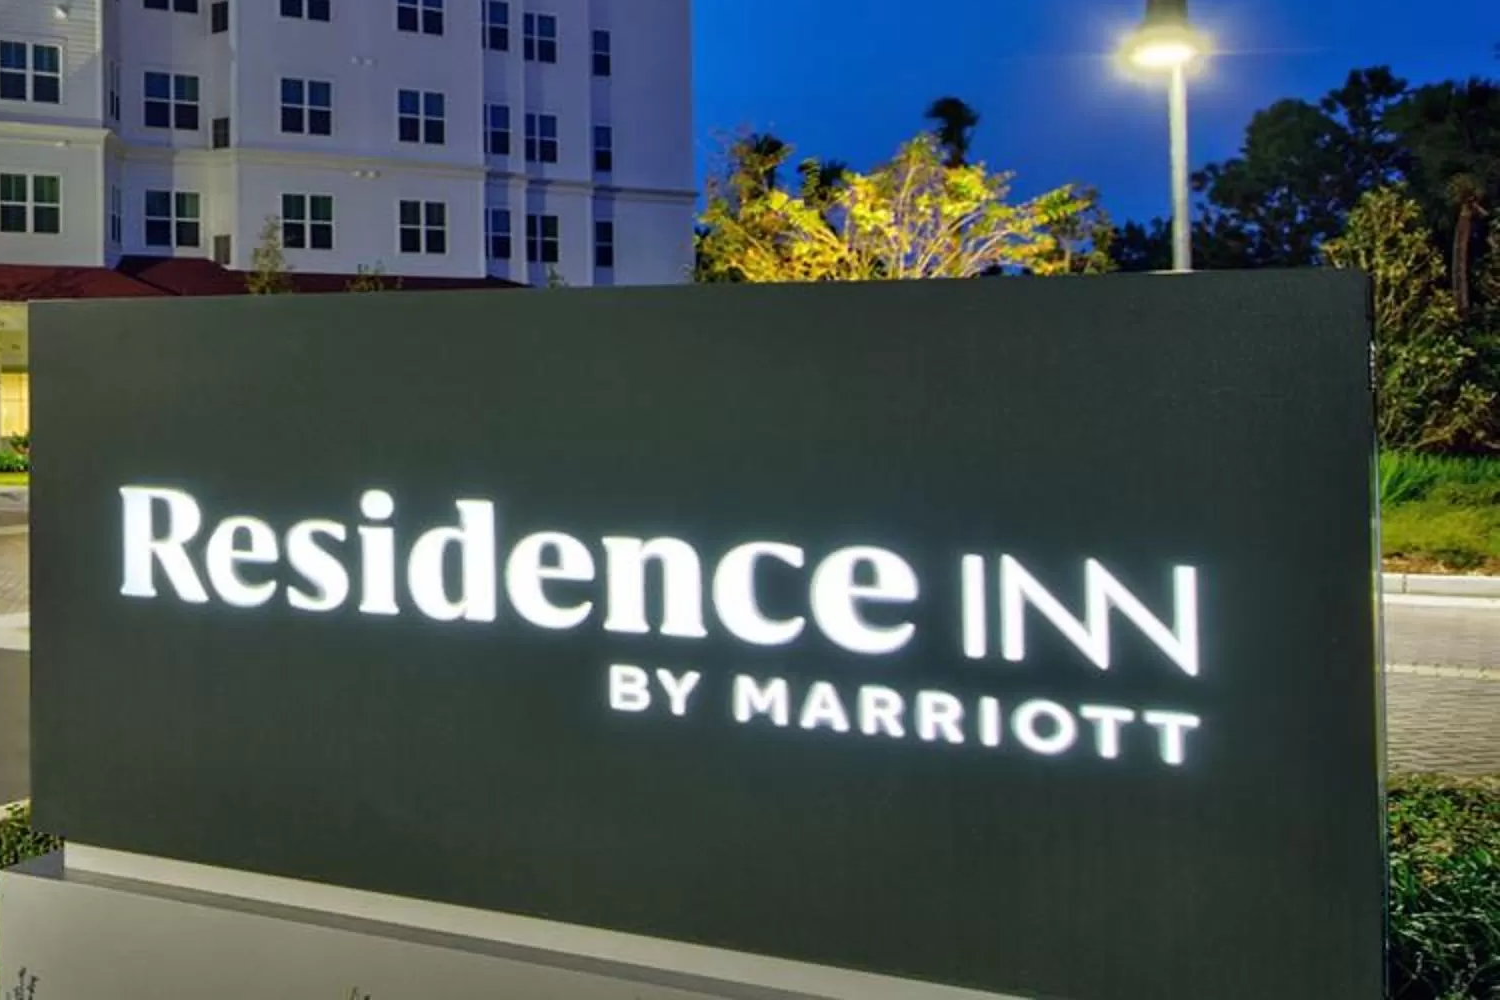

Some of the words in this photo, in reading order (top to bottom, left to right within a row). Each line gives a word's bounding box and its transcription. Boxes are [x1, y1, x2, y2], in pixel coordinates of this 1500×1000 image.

[118, 485, 919, 655] Residence
[961, 553, 1200, 678] INN
[608, 663, 702, 717] BY
[733, 674, 1201, 766] MARRIOTT
